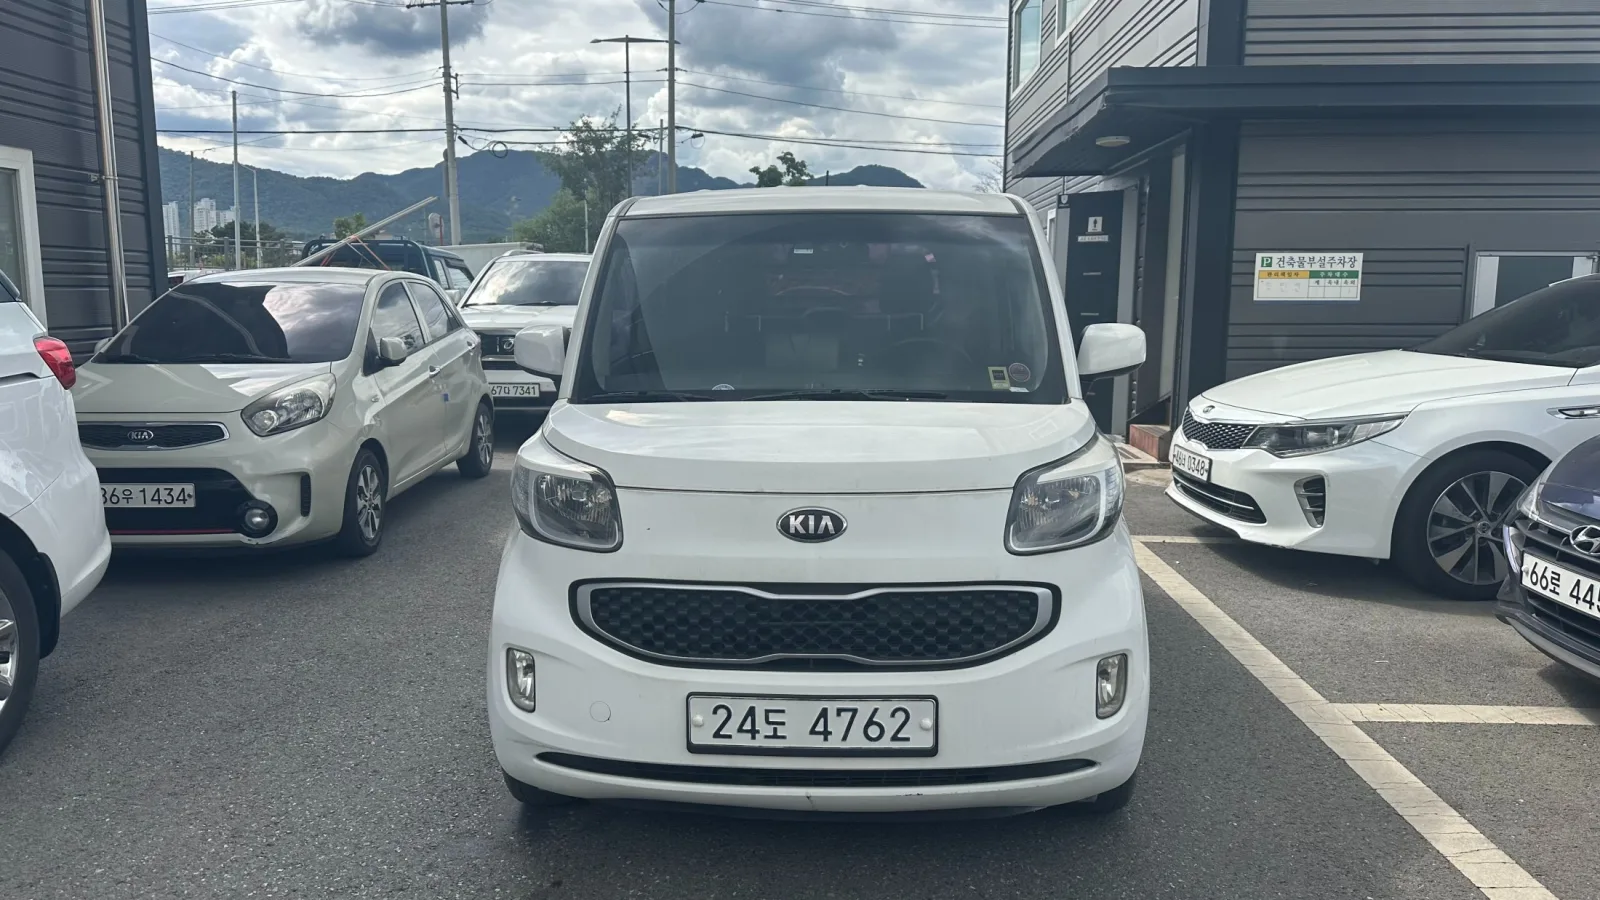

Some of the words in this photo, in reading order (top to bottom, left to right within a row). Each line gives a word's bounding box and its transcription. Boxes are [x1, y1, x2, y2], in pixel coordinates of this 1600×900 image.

[1276, 256, 1358, 269] 건축물부설주차장
[512, 386, 536, 395] 7341
[131, 431, 149, 440] KIA
[1187, 455, 1206, 476] 0348
[139, 487, 188, 505] 1434
[788, 515, 836, 534] KIA
[1529, 561, 1561, 596] 66로
[711, 704, 787, 740] 24도
[808, 706, 911, 743] 4762
